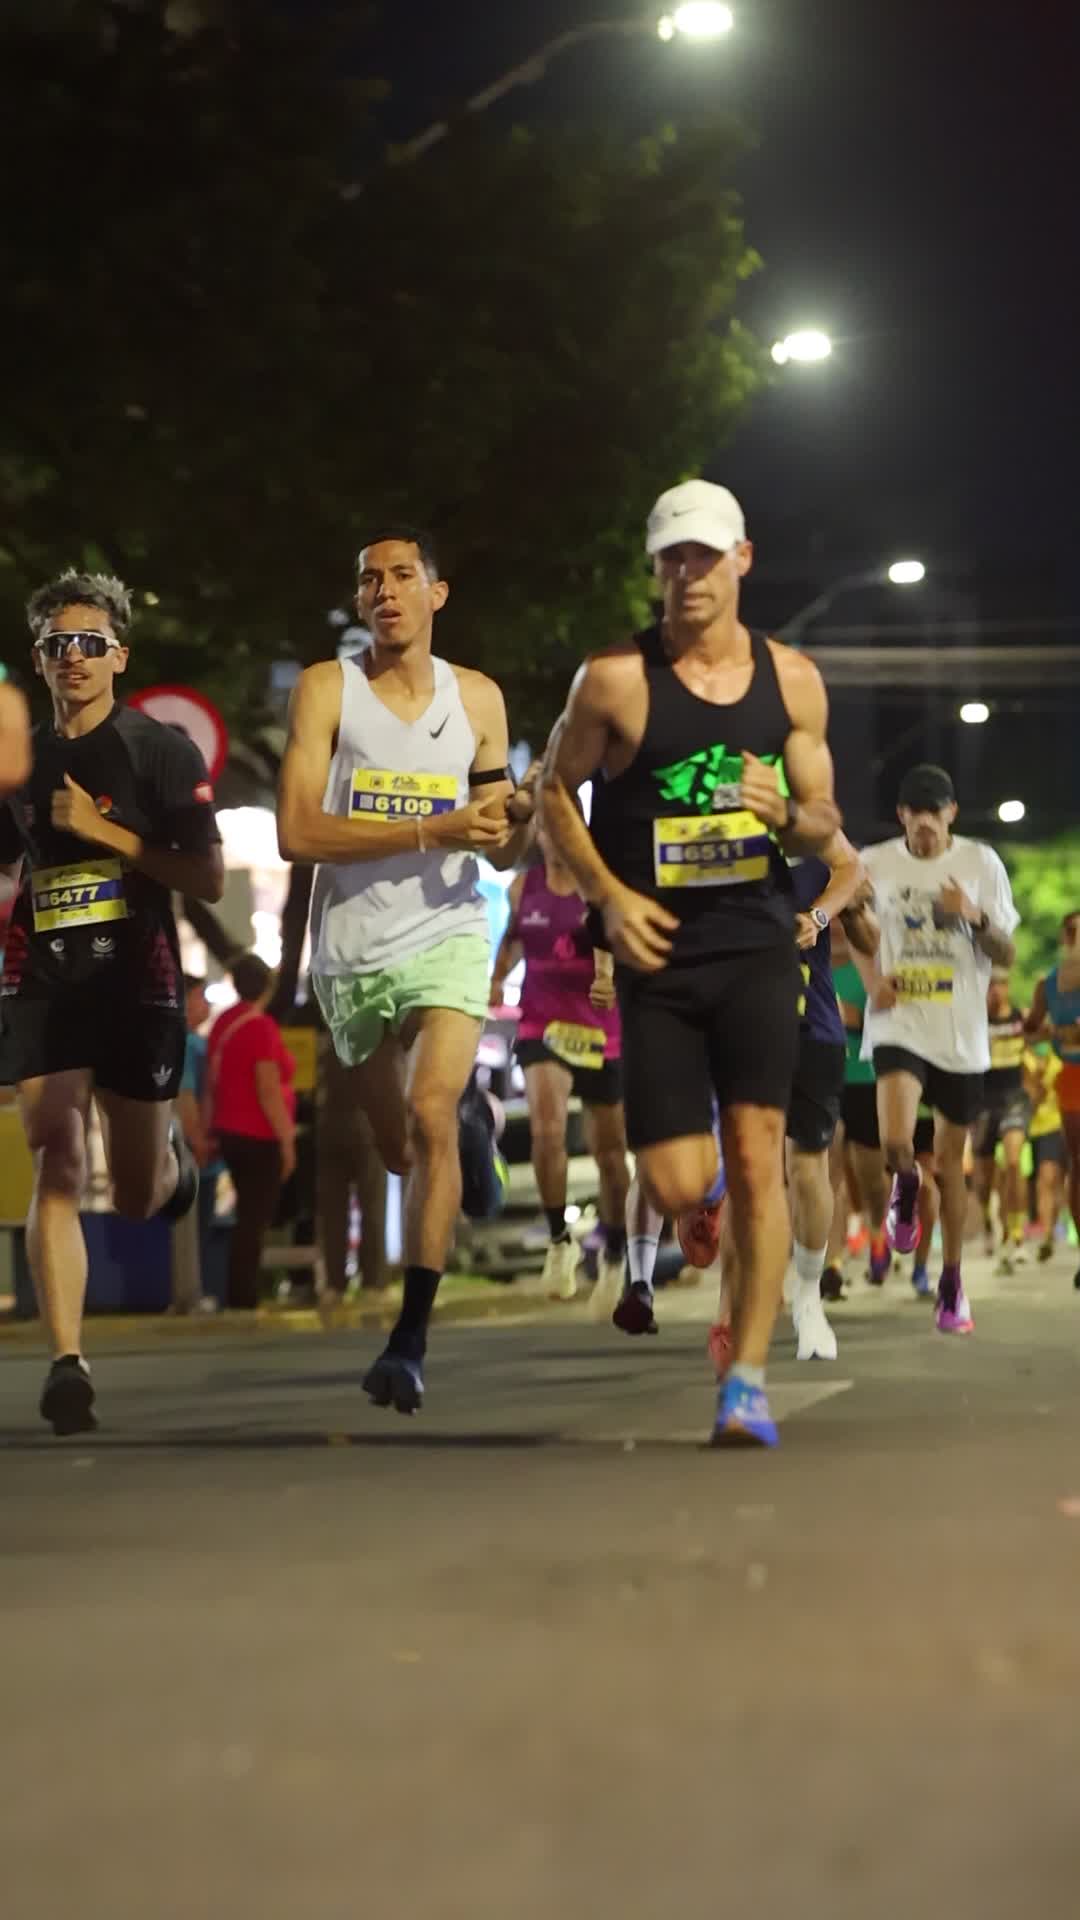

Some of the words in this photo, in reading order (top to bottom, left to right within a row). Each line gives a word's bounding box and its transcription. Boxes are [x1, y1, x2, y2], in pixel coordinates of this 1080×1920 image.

[375, 796, 433, 815] 6109
[684, 841, 744, 861] 6511
[49, 886, 100, 906] 6477
